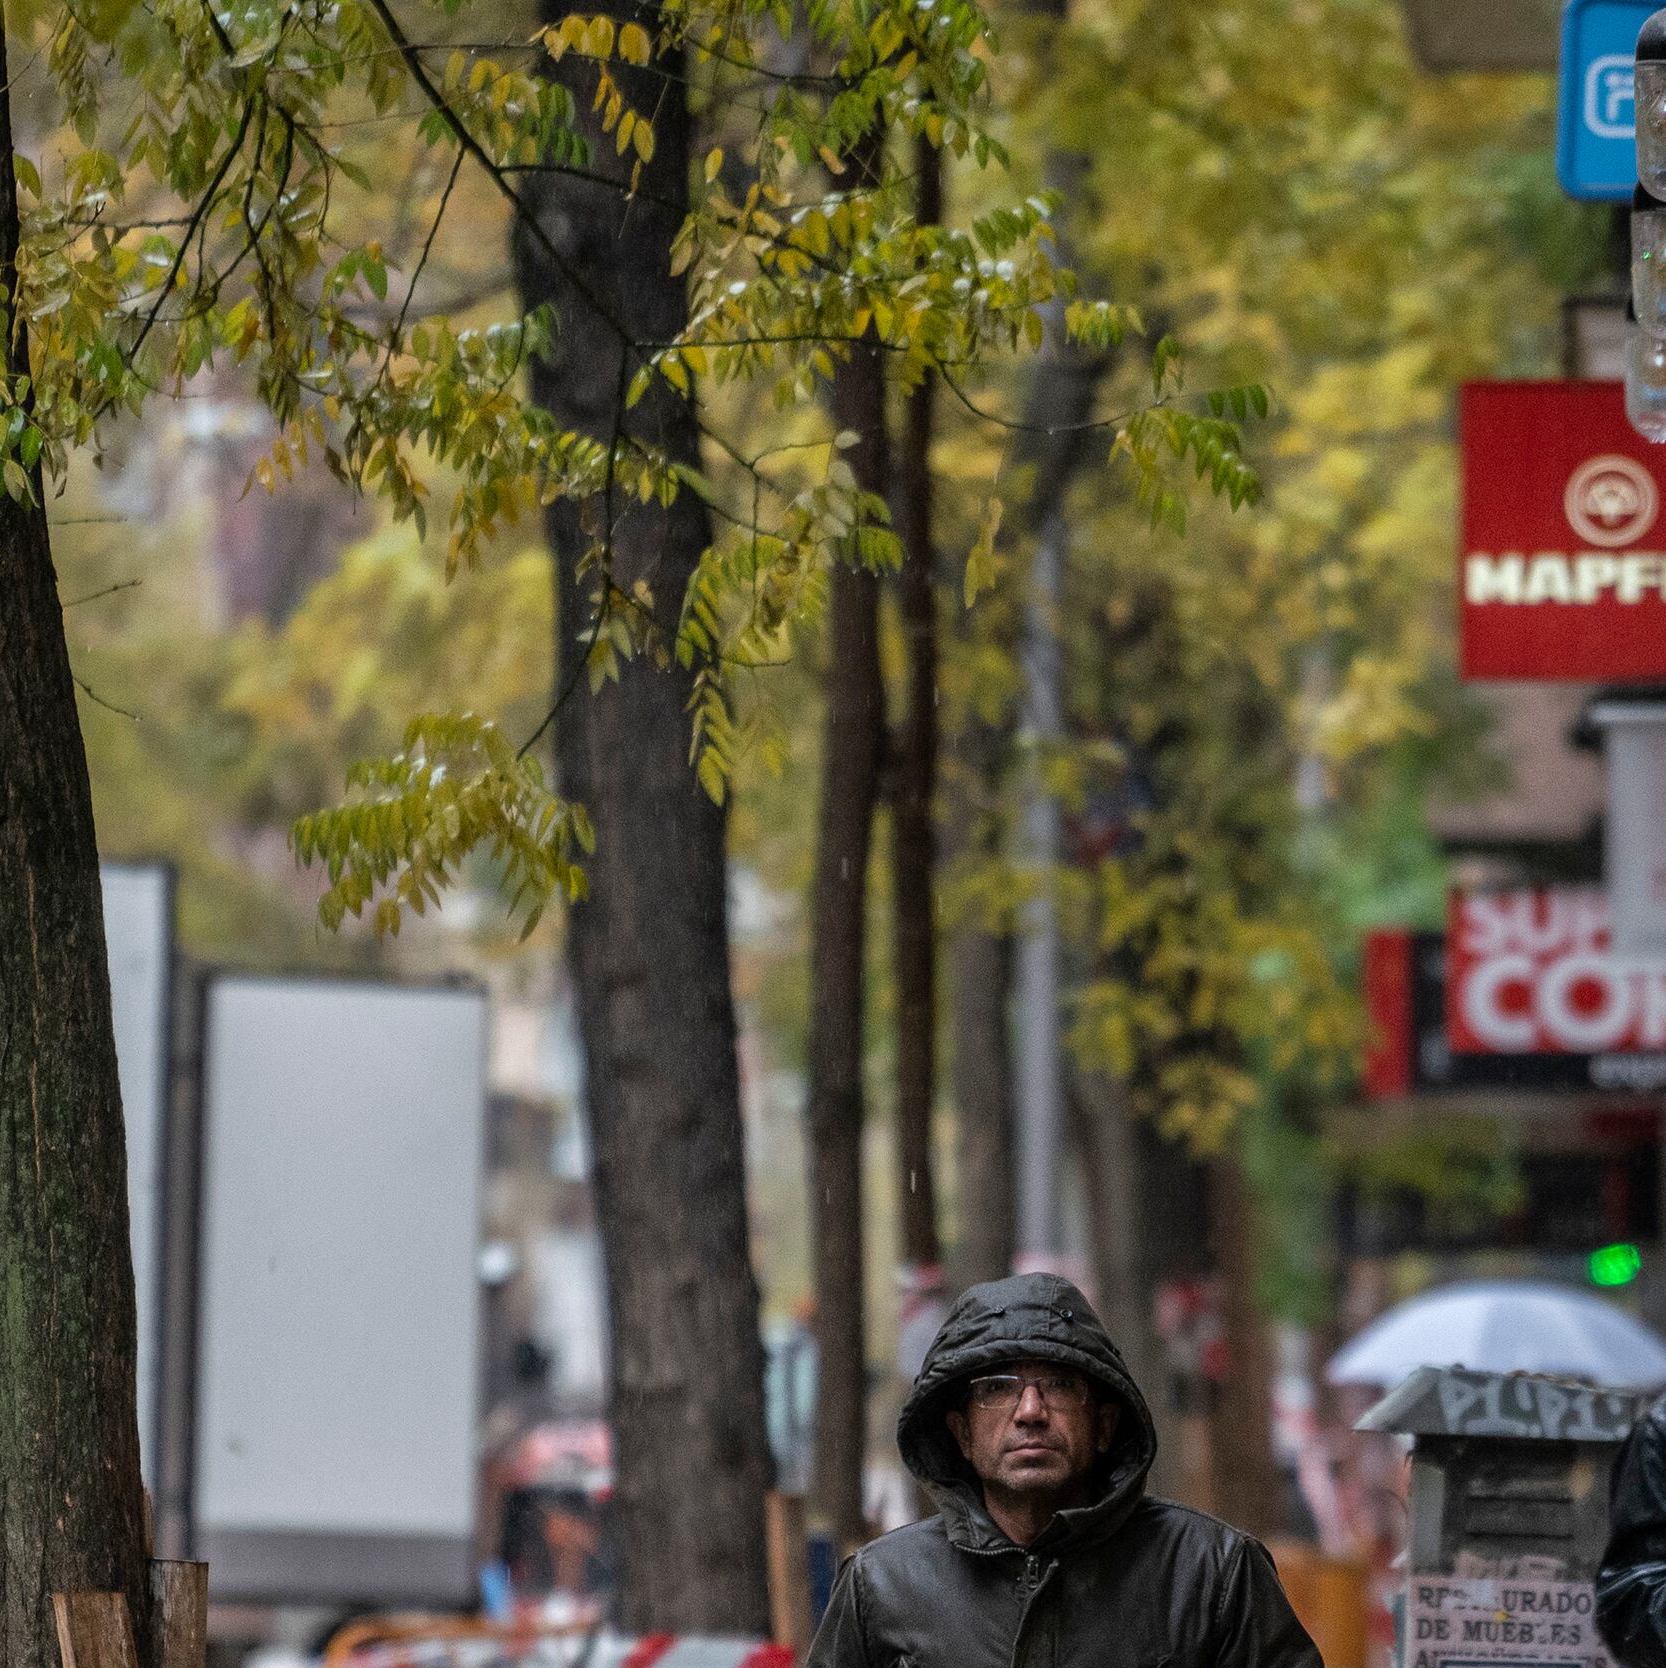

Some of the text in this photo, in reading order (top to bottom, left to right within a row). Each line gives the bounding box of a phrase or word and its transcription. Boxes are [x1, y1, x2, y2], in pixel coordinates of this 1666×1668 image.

[1418, 1586, 1594, 1615] REURADO
[1417, 1617, 1582, 1647] DE MUEBES
